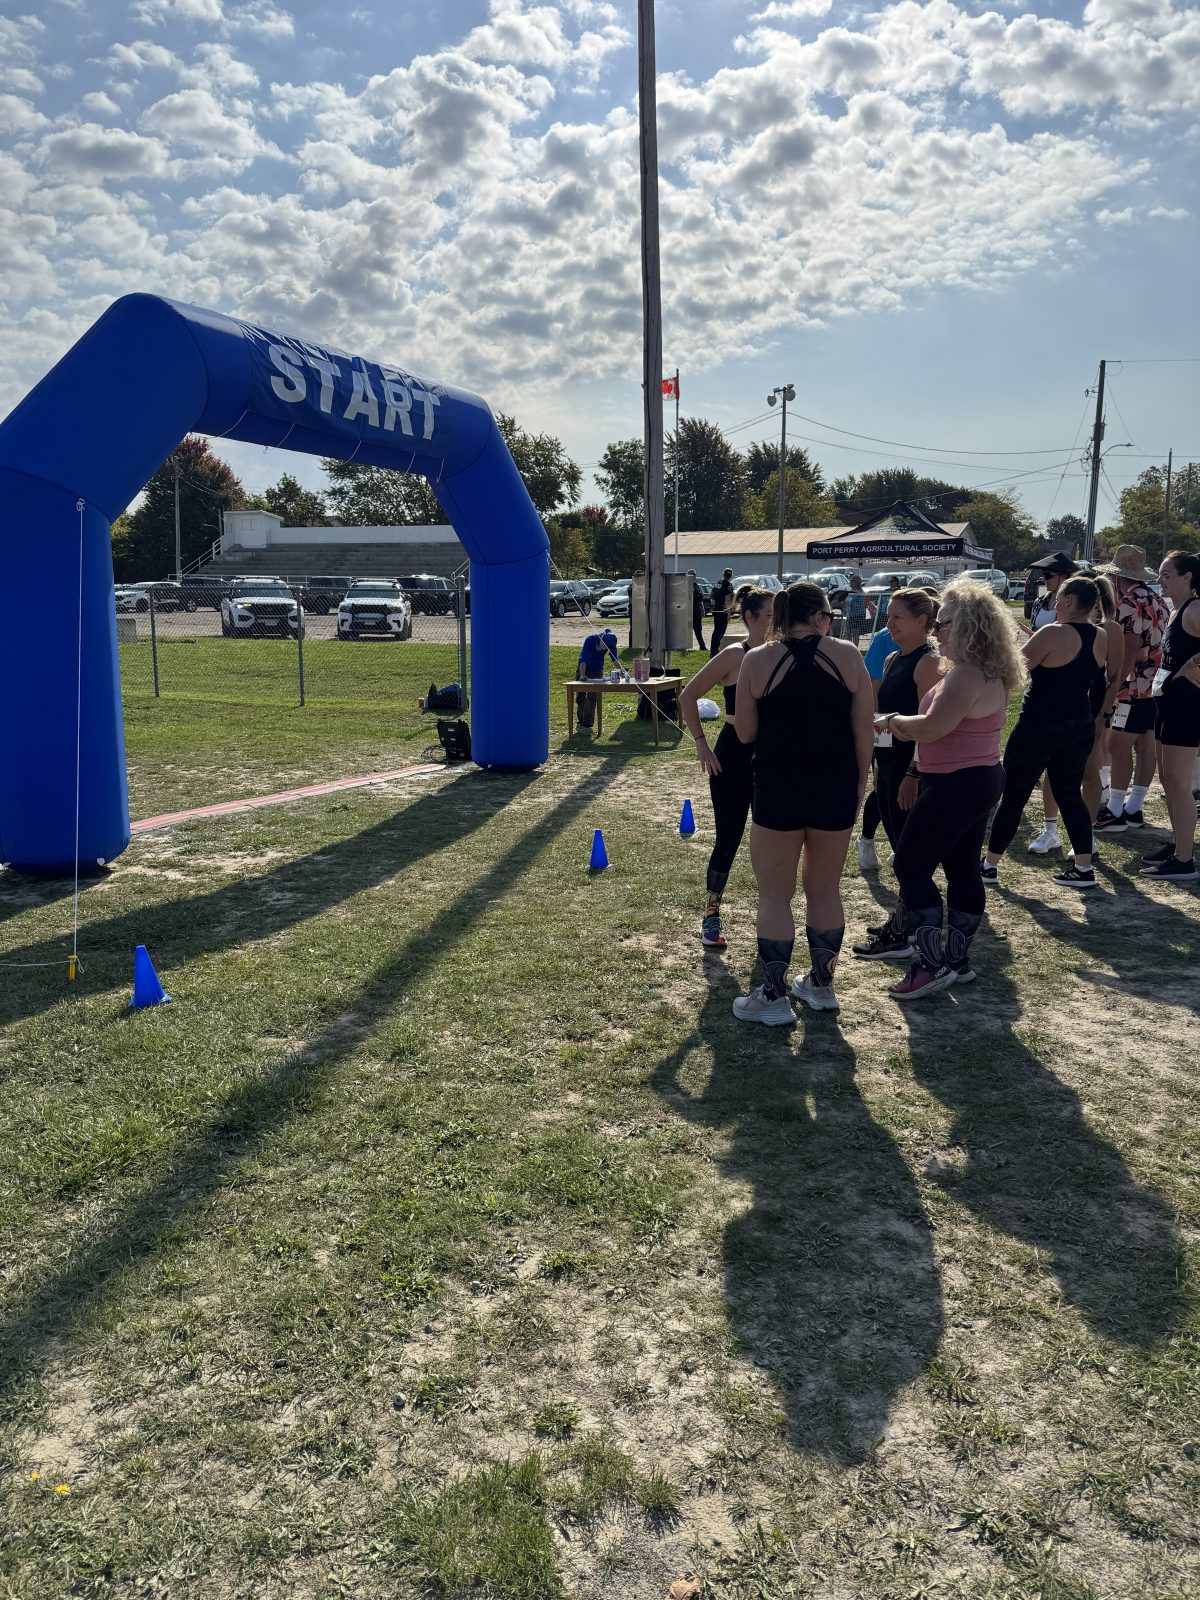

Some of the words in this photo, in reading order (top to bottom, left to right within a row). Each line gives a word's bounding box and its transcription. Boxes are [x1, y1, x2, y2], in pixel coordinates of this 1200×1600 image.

[268, 344, 441, 440] START
[812, 547, 833, 555] PORT
[834, 546, 860, 554] PERRY
[861, 544, 921, 553] AGRICULTURAL
[922, 543, 957, 551] SOCIETY
